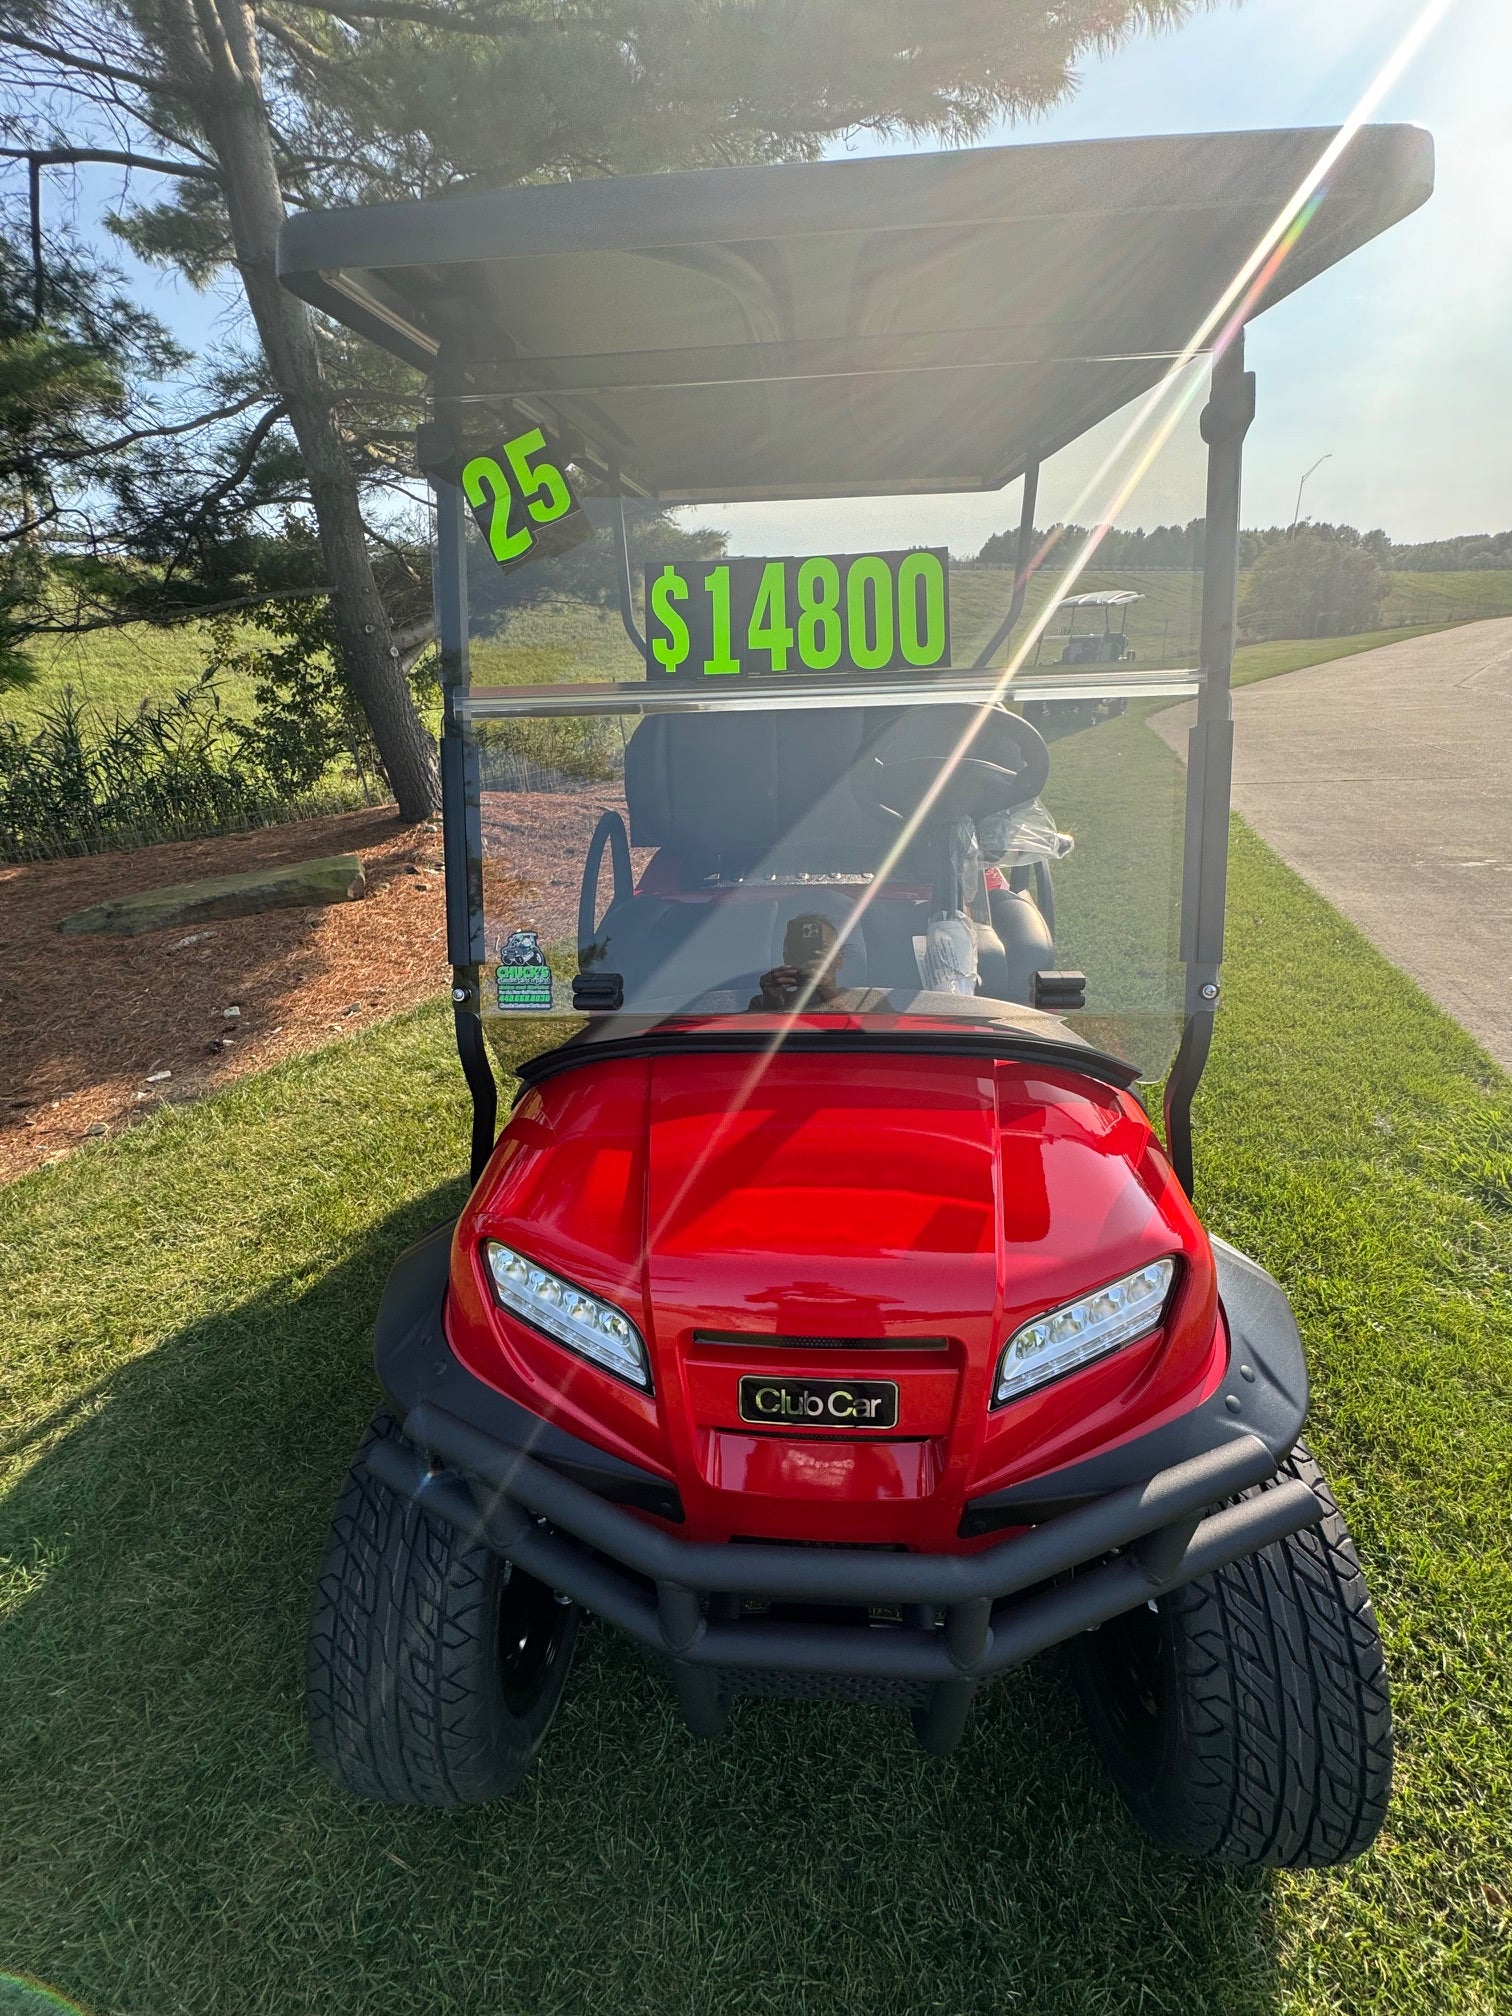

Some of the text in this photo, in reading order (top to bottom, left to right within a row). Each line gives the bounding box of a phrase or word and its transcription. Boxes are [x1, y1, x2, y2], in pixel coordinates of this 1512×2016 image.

[462, 427, 572, 563] 25
[651, 552, 946, 675] $14800
[755, 1387, 882, 1418] Club Car
